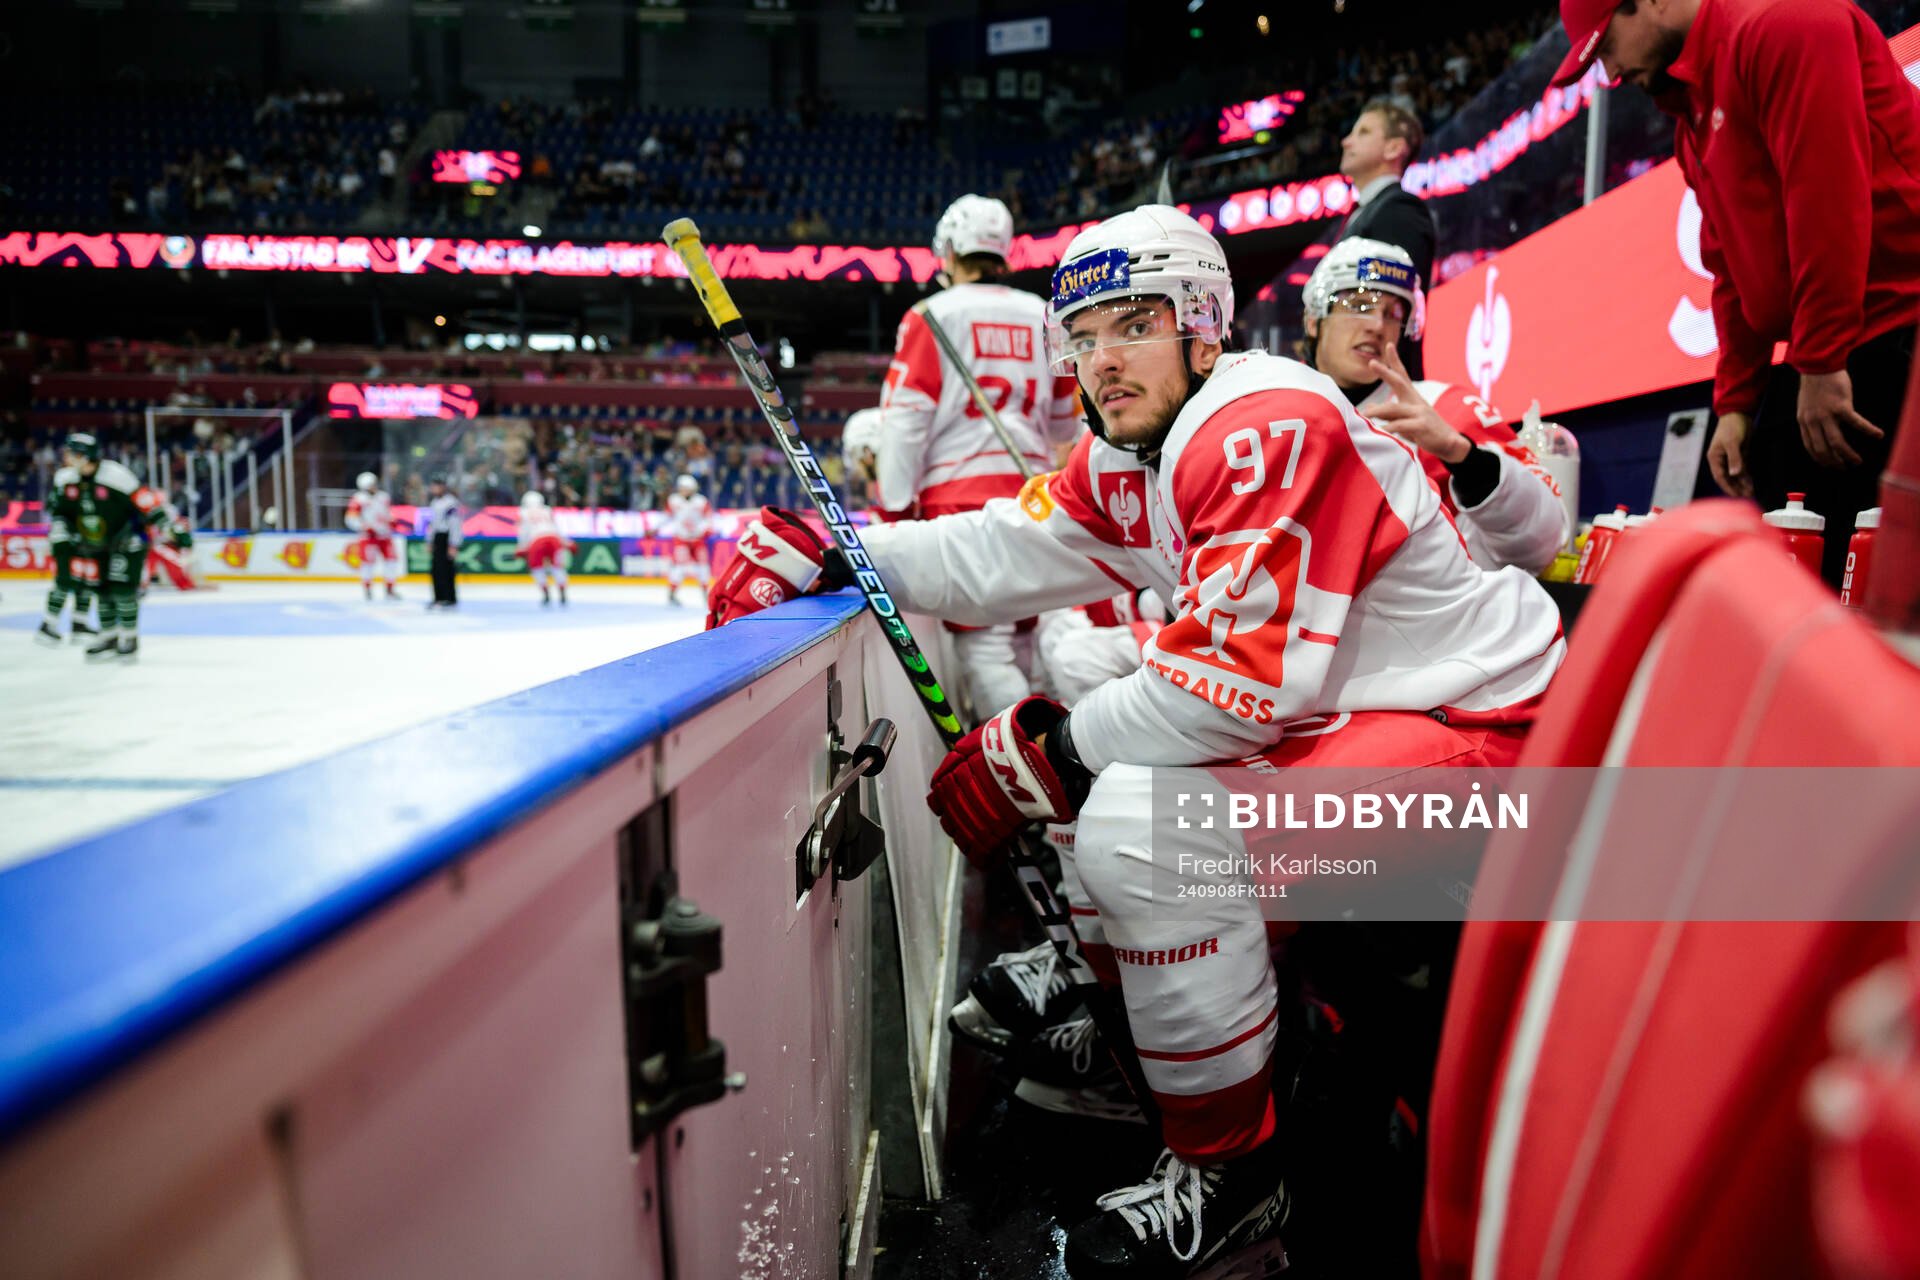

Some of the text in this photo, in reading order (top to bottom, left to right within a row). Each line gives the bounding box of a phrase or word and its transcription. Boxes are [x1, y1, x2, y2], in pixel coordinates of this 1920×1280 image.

[1059, 261, 1111, 296] Hirter
[1198, 259, 1226, 273] CCM
[1223, 418, 1307, 496] 97
[781, 433, 896, 619] JETSPEED
